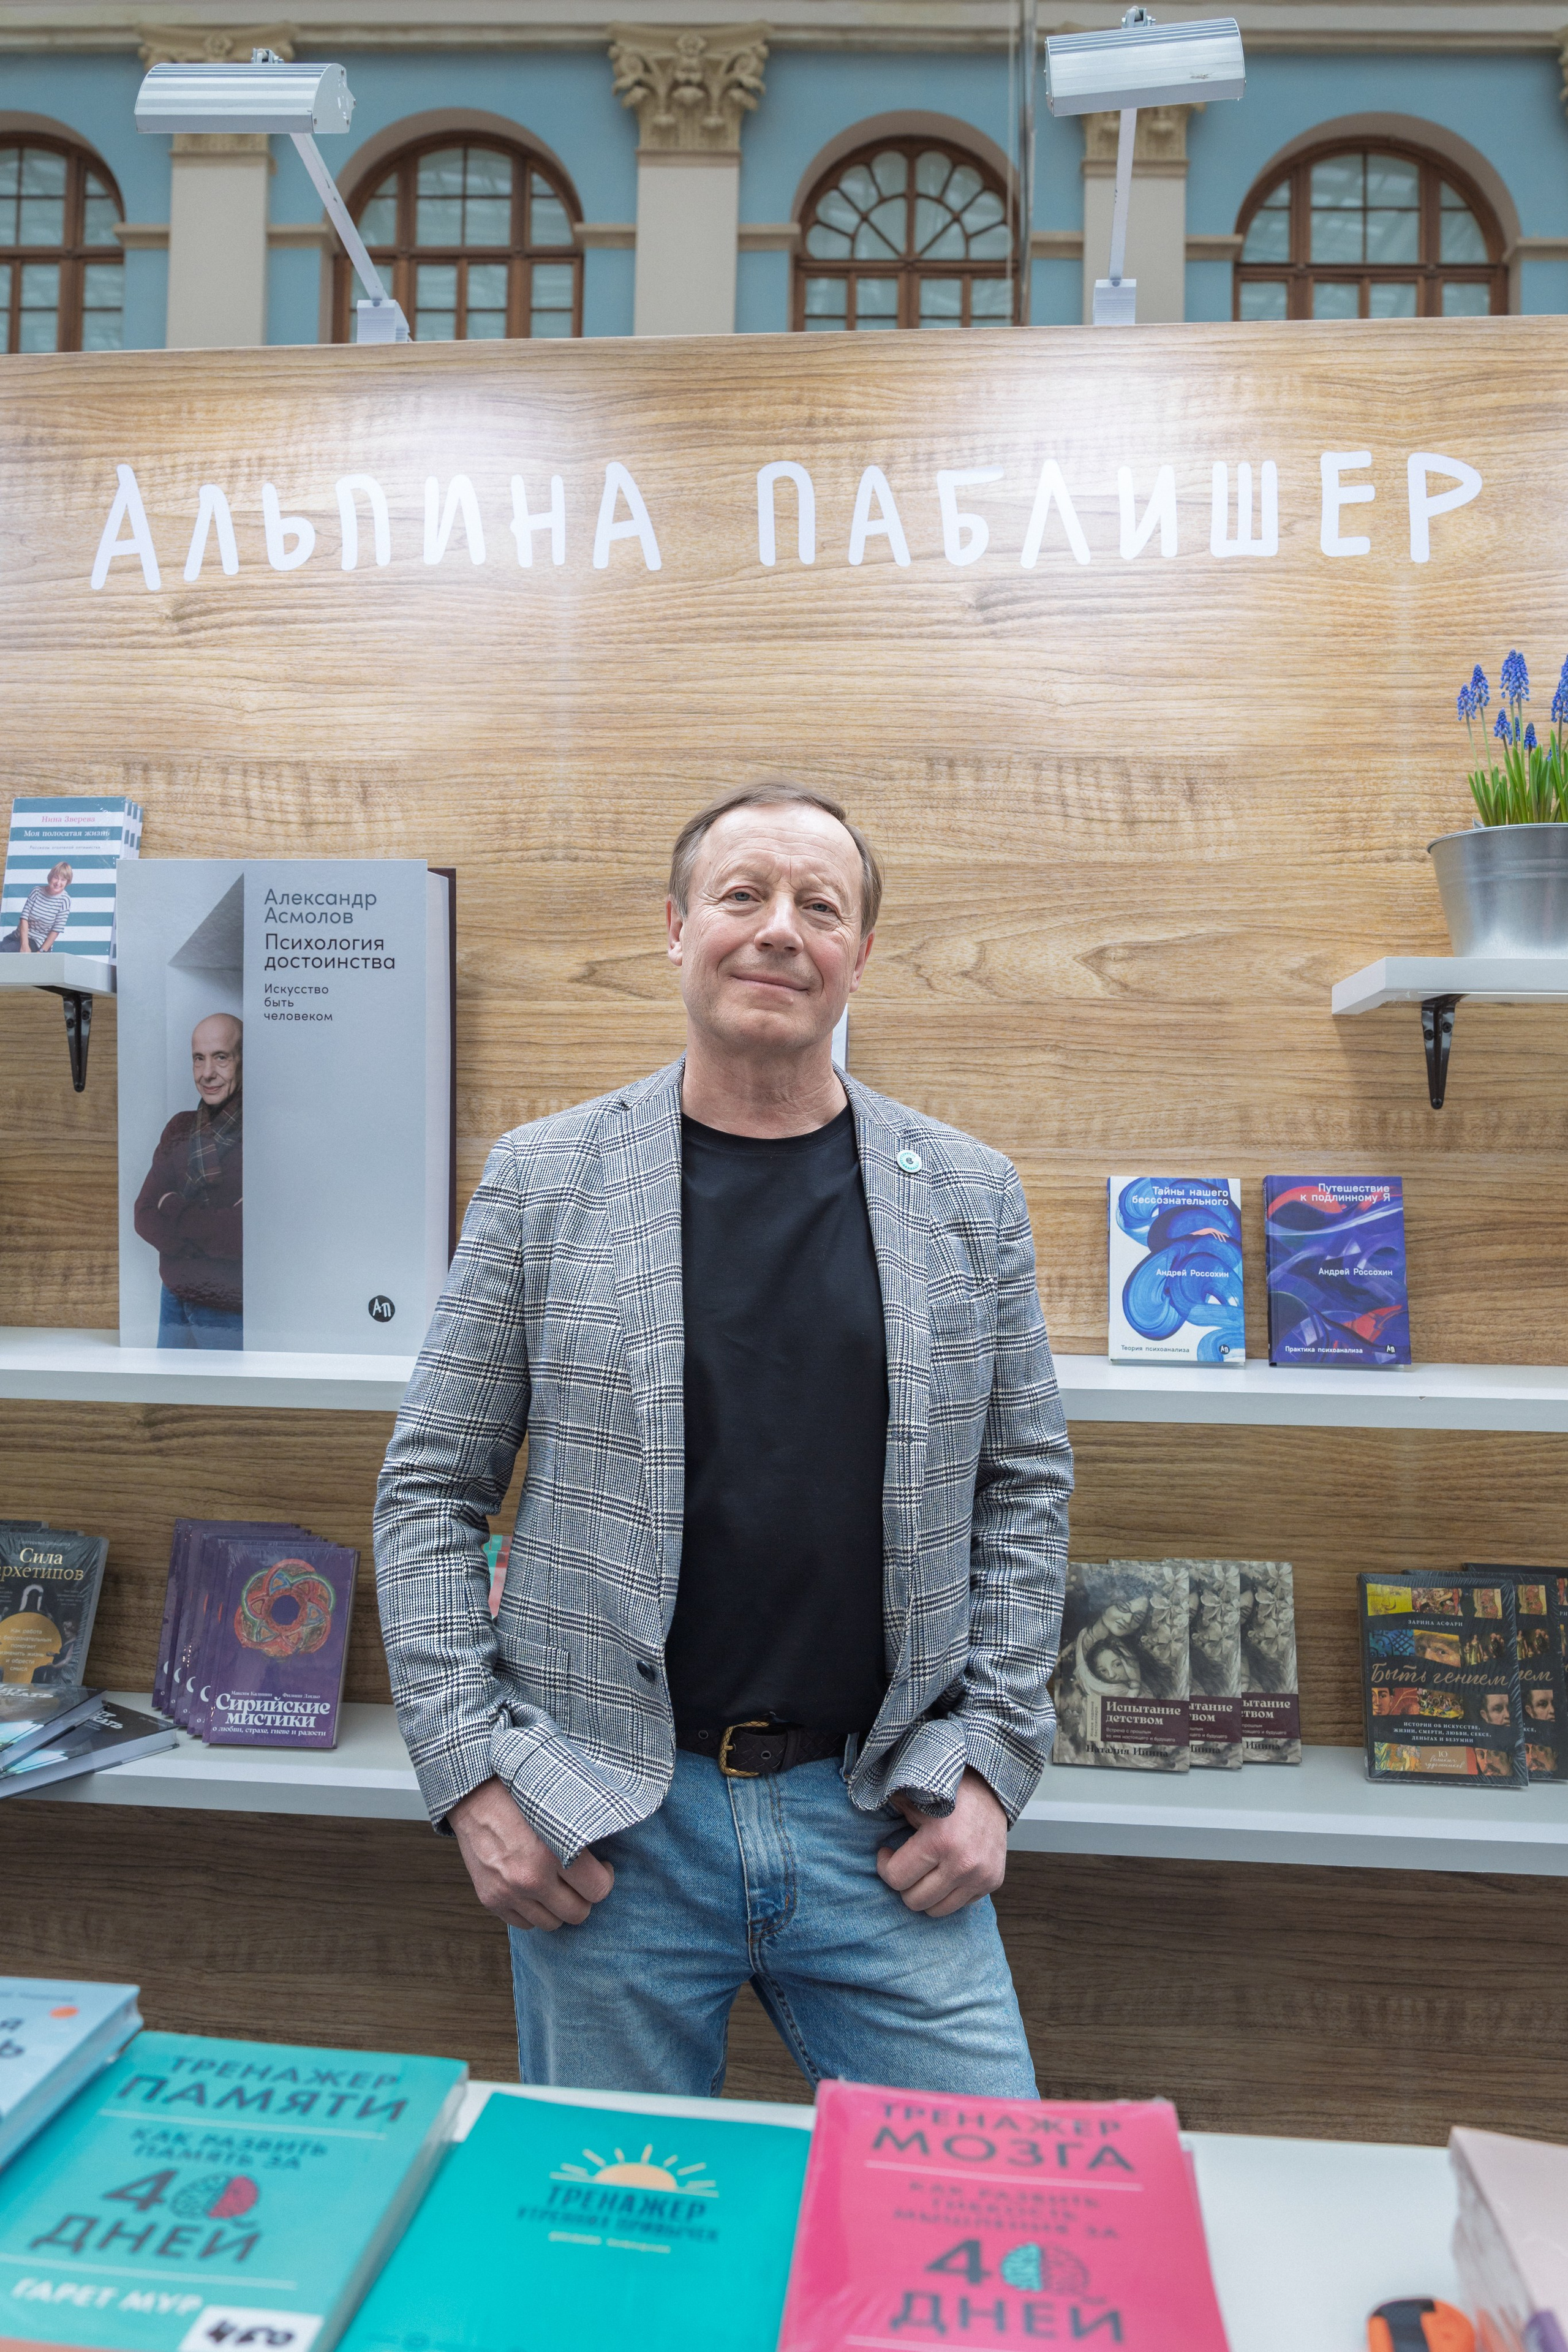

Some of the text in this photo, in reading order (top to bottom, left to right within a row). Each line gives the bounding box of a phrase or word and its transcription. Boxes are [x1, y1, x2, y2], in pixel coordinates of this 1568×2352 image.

[91, 451, 1483, 591] АЛЬПИНА ПАБЛИШЕР
[264, 888, 377, 910] Александр
[264, 907, 353, 924] Асмолов
[266, 933, 384, 950] Психология
[264, 957, 395, 971] достоинства
[265, 984, 329, 997] Искусство
[264, 997, 294, 1007] быть
[1153, 1186, 1185, 1196] Тайны
[1318, 1183, 1390, 1194] Путешествие
[1132, 1195, 1229, 1205] бессознательного
[1383, 1193, 1390, 1201] Я
[1156, 1268, 1229, 1278] Андрей Россохин
[1318, 1267, 1350, 1276] Андрей
[20, 1547, 63, 1564] Сила
[0, 1566, 84, 1582] рхетипов
[1371, 1662, 1509, 1686] Быть гением
[216, 1693, 331, 1715] Сирийские
[1106, 1701, 1182, 1715] Испытание
[1189, 1703, 1233, 1712] ытание
[1243, 1700, 1291, 1708] ытание
[92, 1716, 123, 1729] КАТЬ
[225, 1713, 317, 1728] мистики
[1106, 1715, 1164, 1725] детством
[1086, 1744, 1169, 1757] Наталия Инина
[170, 2056, 403, 2090] ТРЕНАЖЕР
[116, 2075, 409, 2122] ПАМЯТИ
[878, 2102, 1122, 2138] ТРЕНАЖЕР
[130, 2127, 191, 2146] КАК
[871, 2125, 1136, 2173] МОЗГА
[262, 2155, 301, 2170] ЗА
[547, 2185, 707, 2222] ТРЕНАЖЕР
[28, 2213, 262, 2264] ДНЕЙ
[10, 2277, 203, 2315] ГАРЕТ МУР
[889, 2288, 1126, 2345] ДНЕЙ
